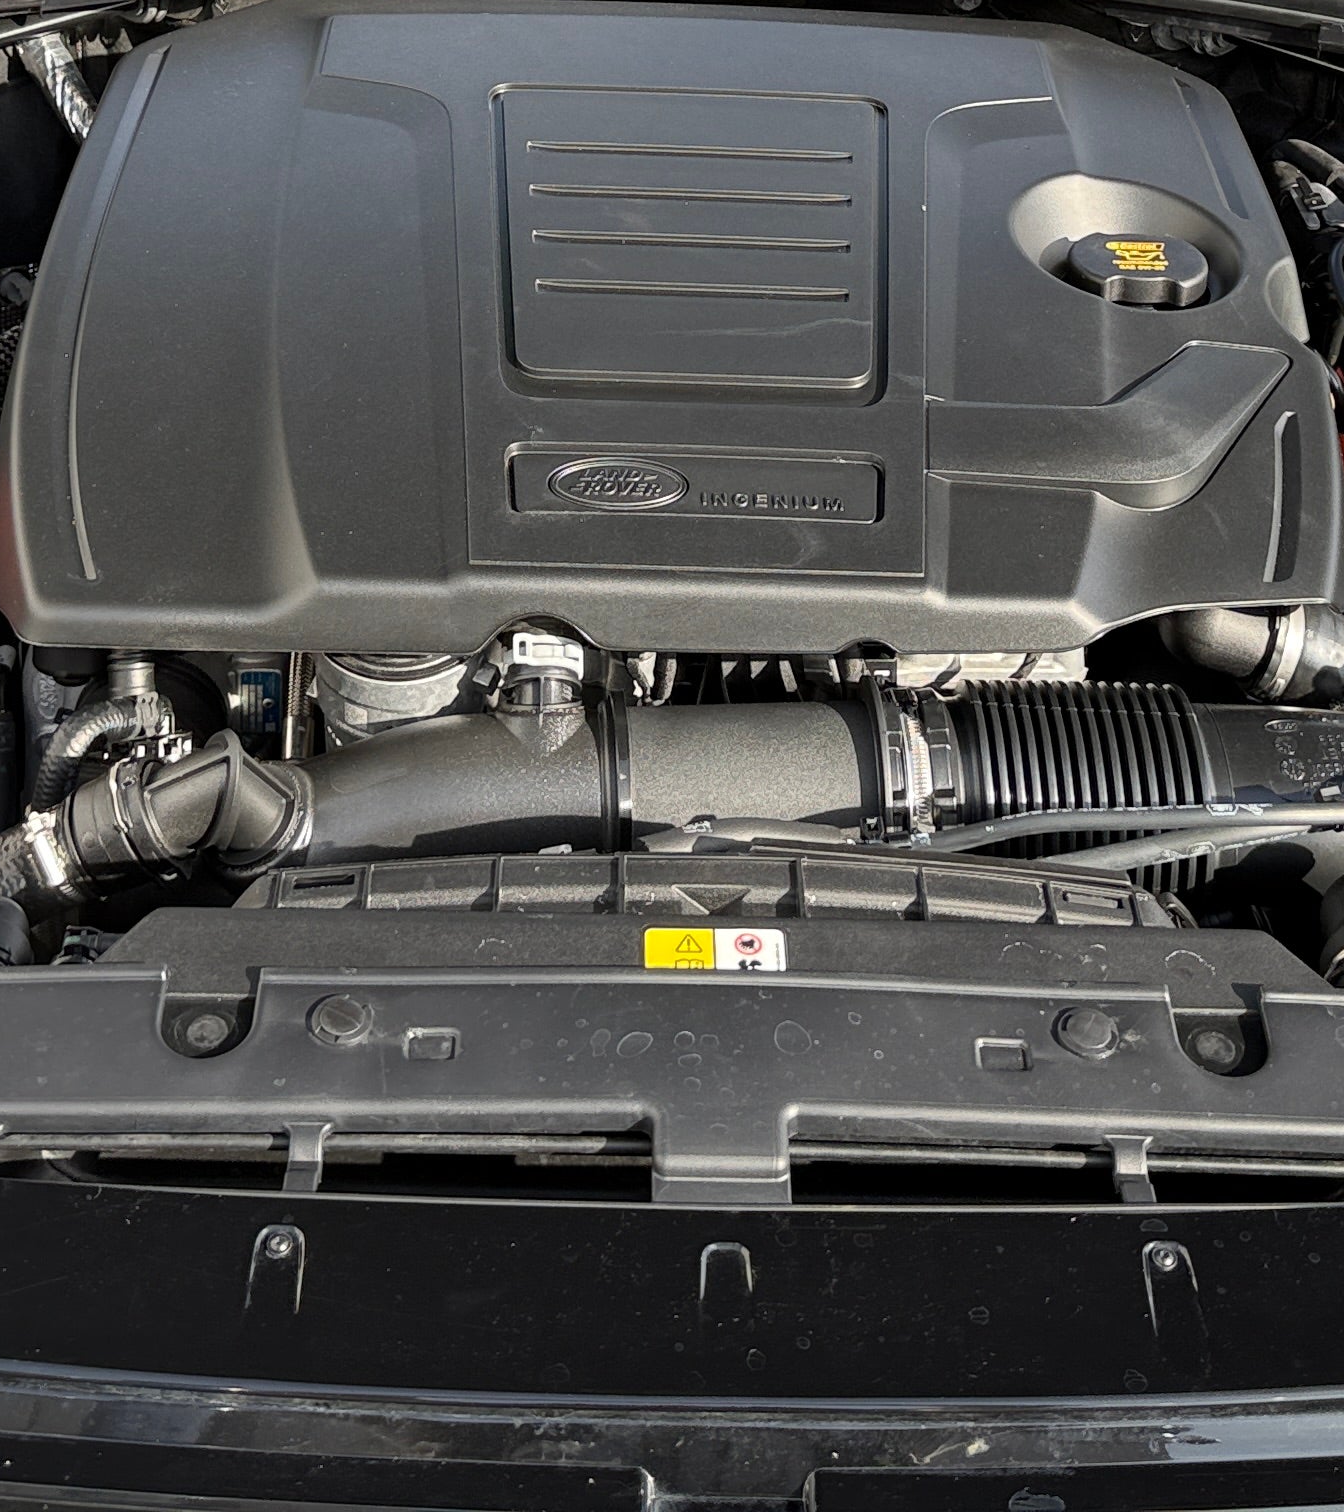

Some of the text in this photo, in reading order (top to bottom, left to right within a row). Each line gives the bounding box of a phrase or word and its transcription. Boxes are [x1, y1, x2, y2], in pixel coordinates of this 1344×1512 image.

[579, 468, 645, 482] LAND
[583, 481, 663, 498] ROVER
[699, 491, 846, 513] INGENIUM
